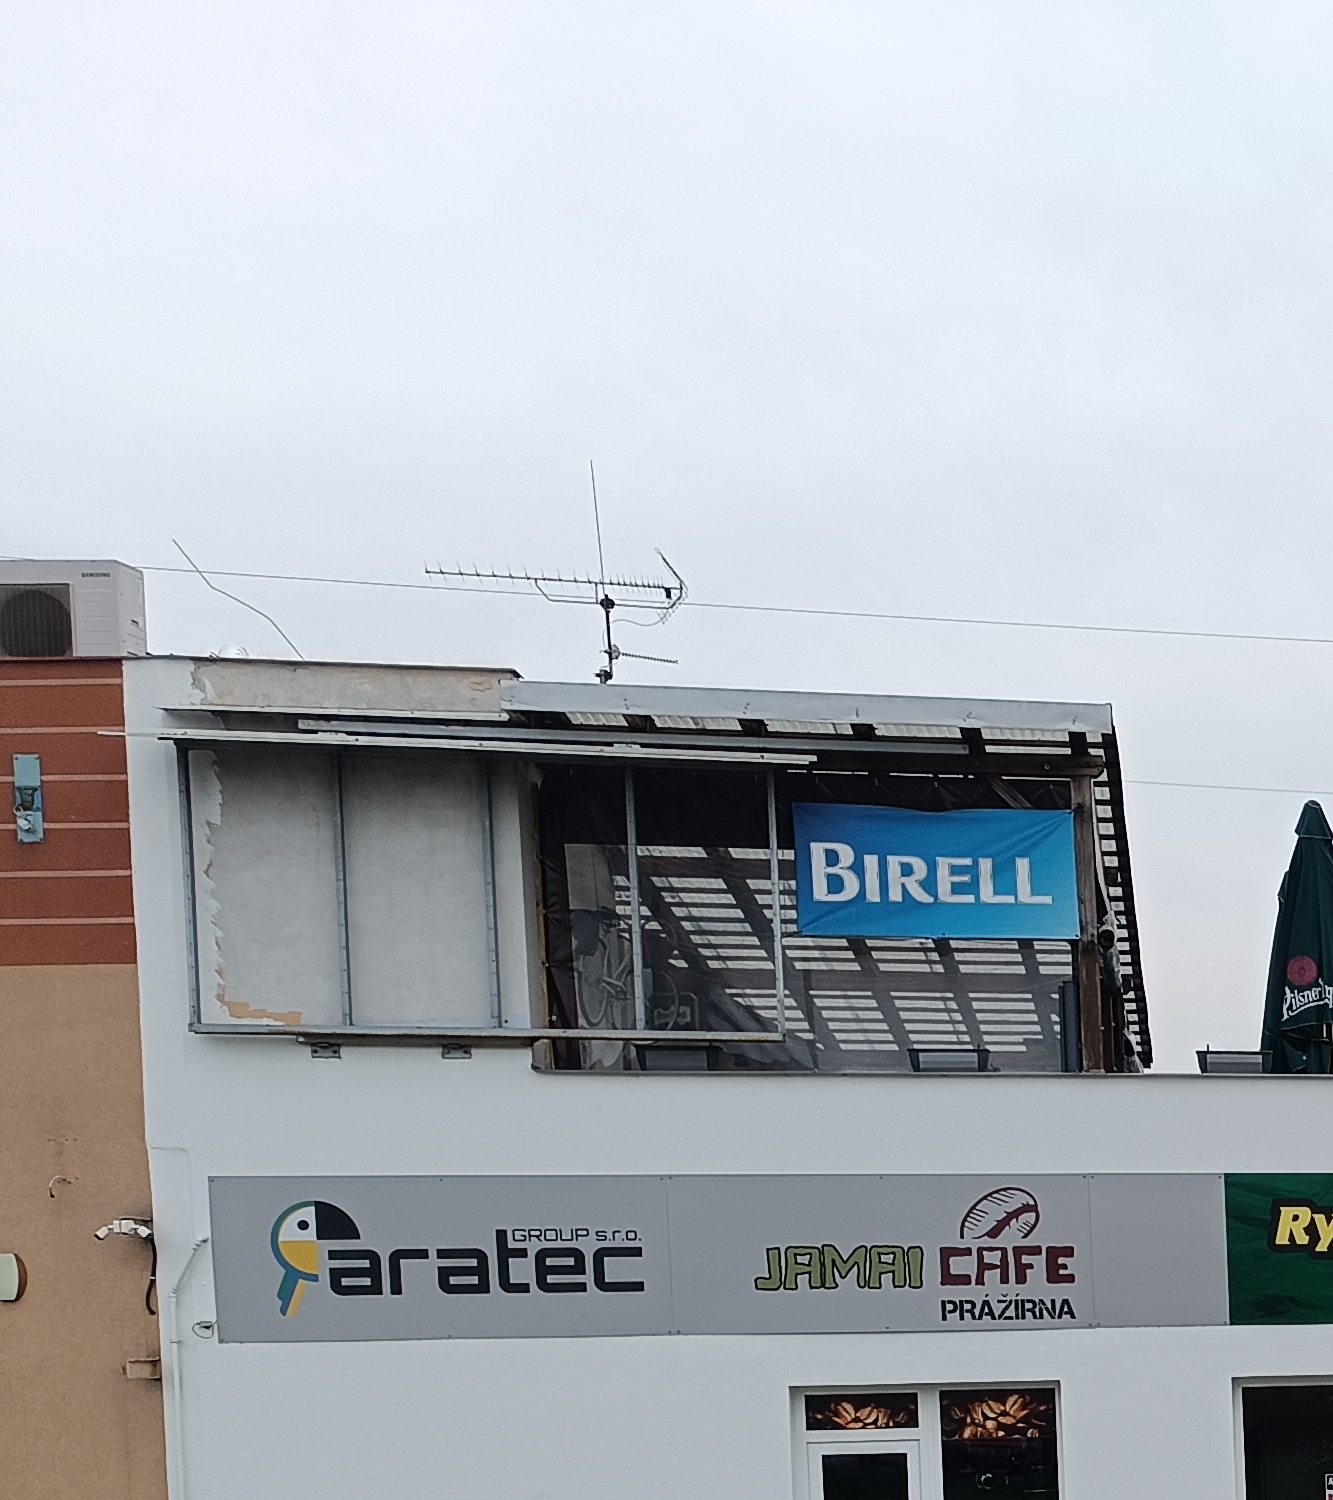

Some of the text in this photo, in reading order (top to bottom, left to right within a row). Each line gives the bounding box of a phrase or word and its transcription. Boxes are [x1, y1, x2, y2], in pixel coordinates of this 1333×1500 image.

[809, 842, 1053, 904] BIRELL
[512, 1228, 643, 1243] GROUP s.r.o.
[327, 1229, 645, 1296] aratec
[754, 1244, 1076, 1291] JAMAI CAFE
[940, 1294, 1077, 1322] PRÁŽÍRNA
